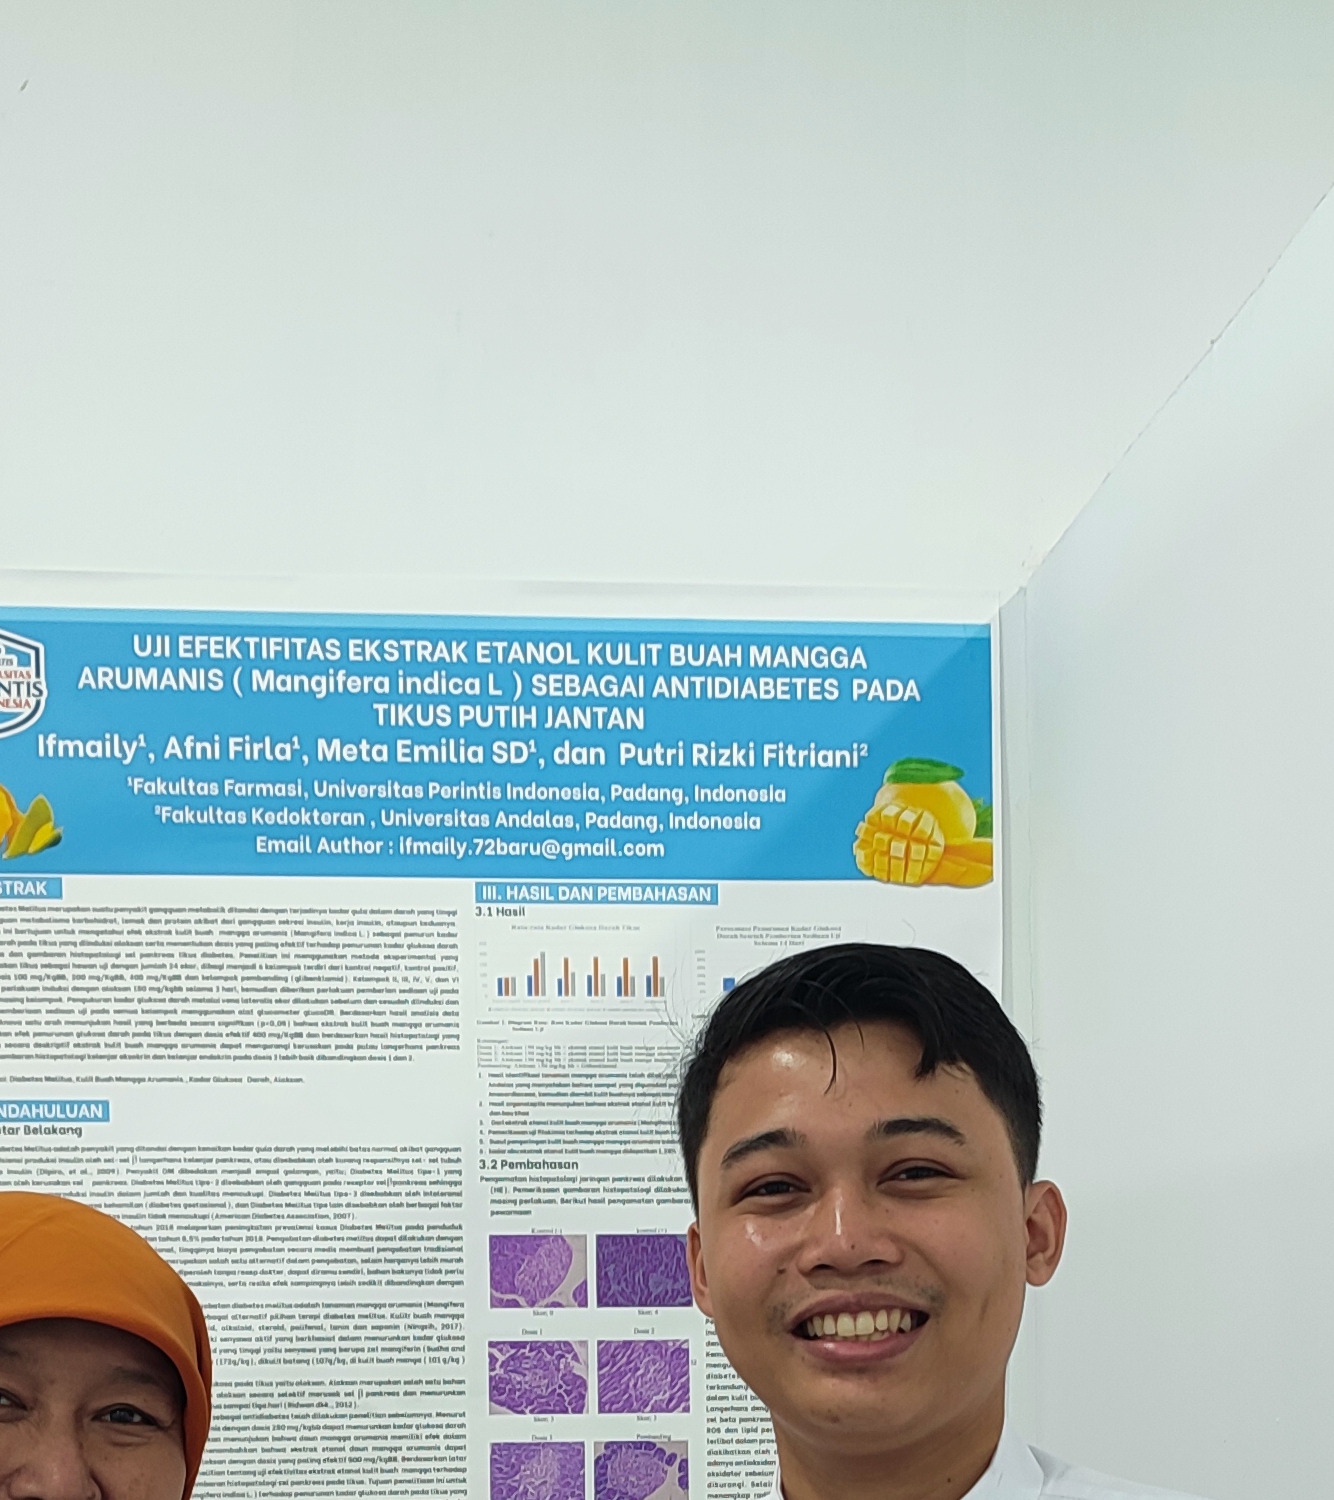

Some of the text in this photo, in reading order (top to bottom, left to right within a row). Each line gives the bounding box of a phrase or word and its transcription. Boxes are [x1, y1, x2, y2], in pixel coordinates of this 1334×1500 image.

[134, 635, 867, 668] UJI EFEKTIFITAS EKSTRAK ETANOL KULIT BUAH MANGGA
[79, 667, 920, 701] ARUMANIS ( Mangifera indica L ) SEBAGAI ANTIDIABETES PADA
[373, 704, 643, 729] TIKUS PUTIH JANTAN
[164, 735, 219, 759] Afni
[318, 739, 387, 761] Meta
[397, 738, 483, 763] Emilia
[554, 741, 605, 764] dan
[620, 741, 683, 765] Putri
[693, 742, 754, 766] Rizki
[225, 779, 308, 798] Farmasi,
[314, 780, 423, 798] Universitas
[429, 782, 501, 799] Perintis
[507, 782, 605, 803] Indonesia,
[611, 784, 688, 805] Padang,
[695, 785, 785, 802] Indonesia
[252, 808, 364, 825] Kedokteran
[382, 809, 489, 827] Universitas
[496, 810, 579, 830] Andalas,
[586, 811, 663, 833] Padang,
[670, 812, 760, 829] Indonesia
[257, 836, 664, 860] Email Author : ifmaily.72baru@gmail.com
[482, 886, 711, 903] III. HASIL DAN PEMBAHASAN
[475, 906, 526, 918] 3.1 Hasil
[24, 1123, 83, 1138] Belakang
[479, 1159, 579, 1170] 3.2 Pembahasan
